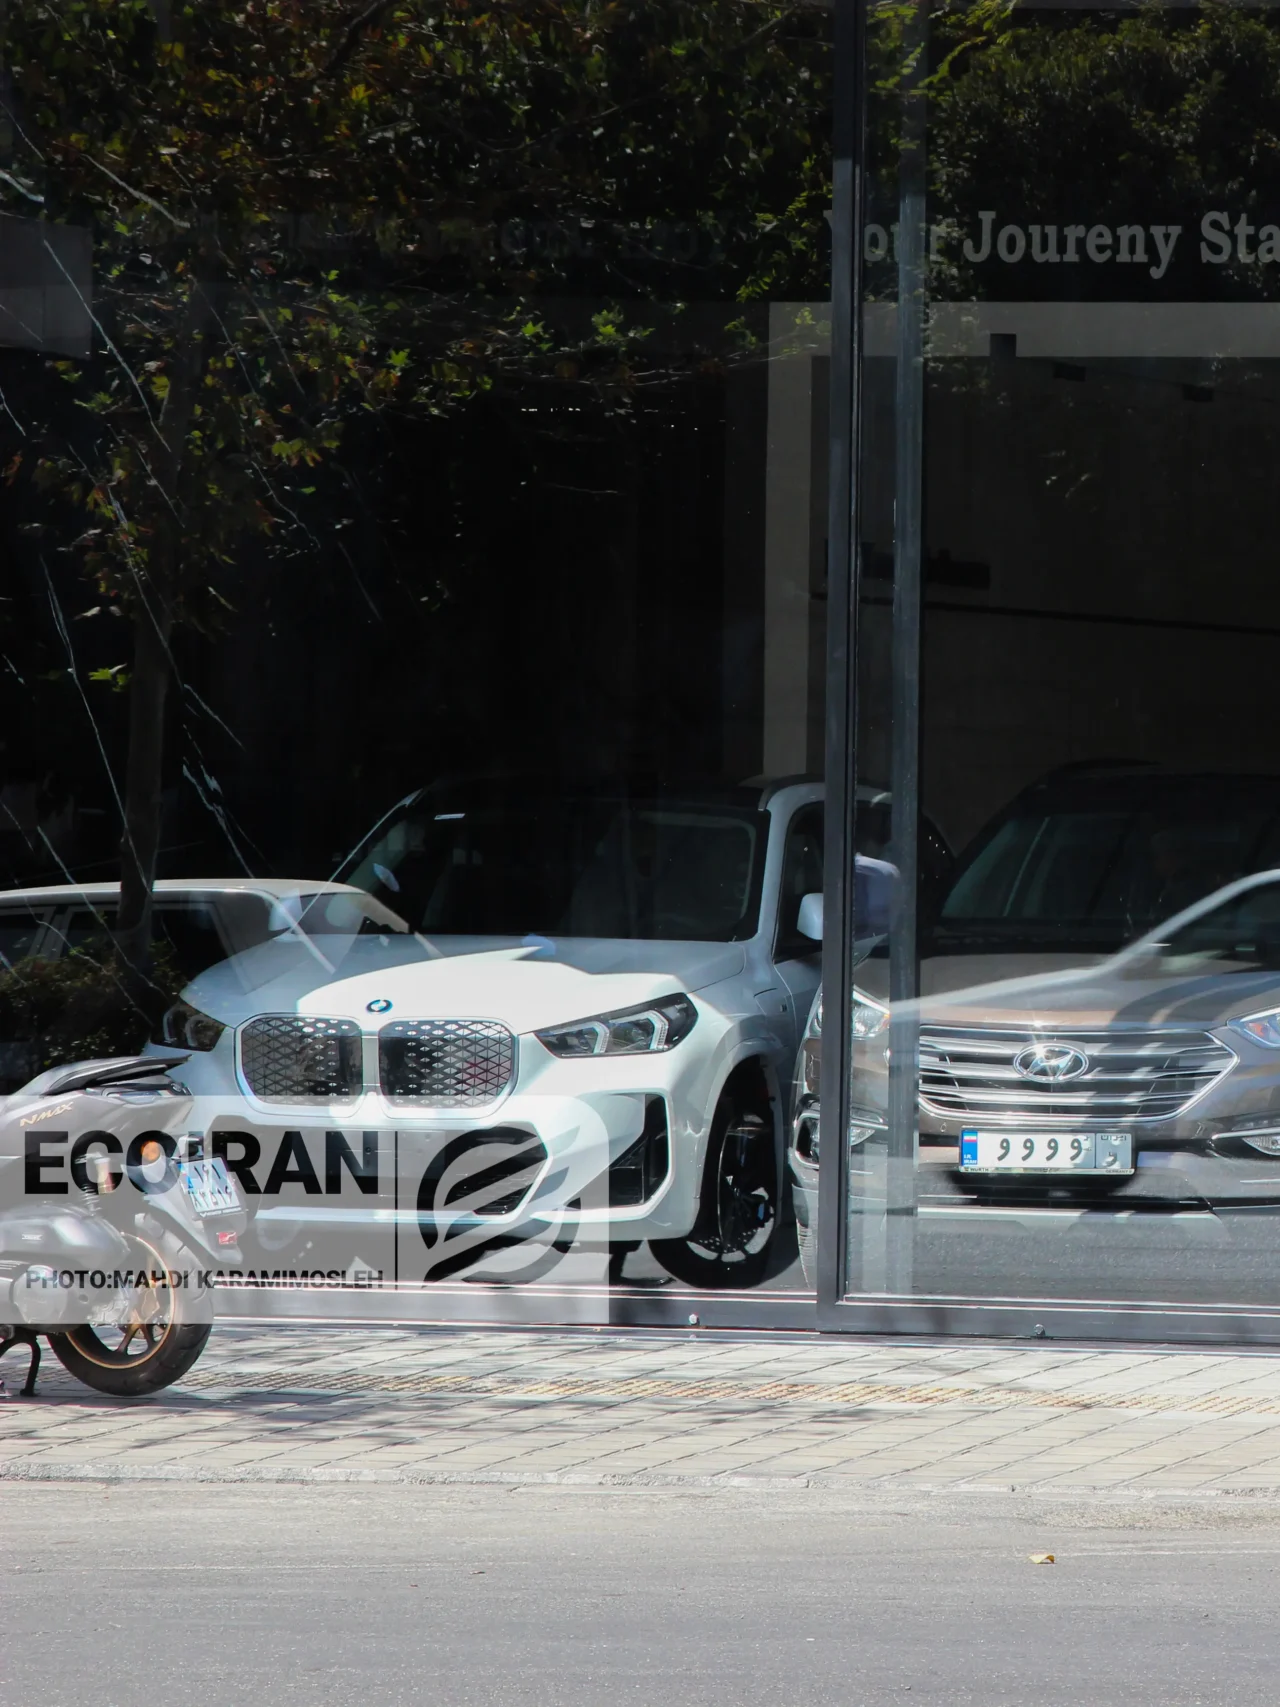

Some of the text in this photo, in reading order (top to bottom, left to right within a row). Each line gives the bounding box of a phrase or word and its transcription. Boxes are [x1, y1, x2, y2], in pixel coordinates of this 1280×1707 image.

[823, 209, 951, 263] or
[963, 210, 1181, 279] Joureny
[19, 1101, 74, 1127] NMAX
